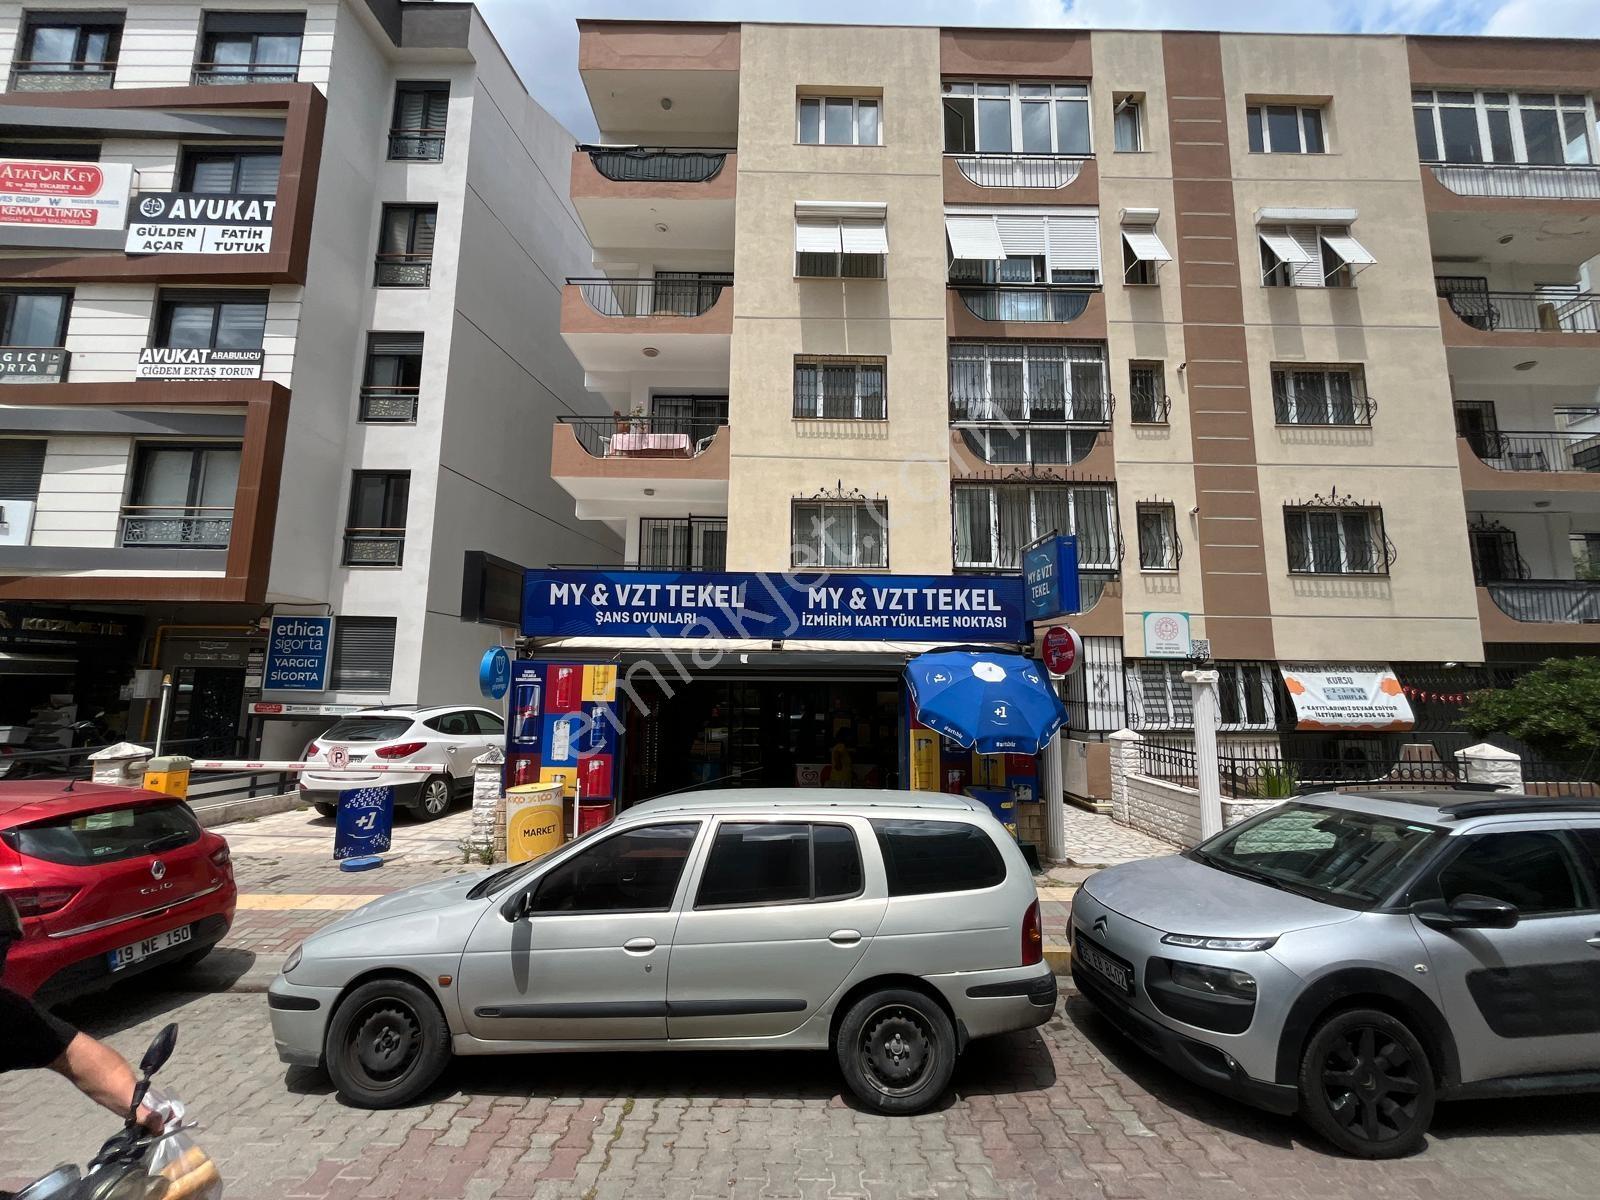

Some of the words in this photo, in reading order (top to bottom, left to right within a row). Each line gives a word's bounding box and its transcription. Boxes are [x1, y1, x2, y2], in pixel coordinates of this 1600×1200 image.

[168, 199, 277, 220] AVUKAT
[136, 226, 197, 238] GÜLDEN
[221, 228, 263, 239] FATİH
[142, 241, 183, 252] AÇAR
[214, 242, 265, 252] TUTUK
[140, 349, 211, 363] AVUKAT
[211, 352, 261, 360] ARABULUCU
[141, 365, 181, 376] ÇİĞDEM
[220, 367, 254, 376] TORUN
[550, 583, 586, 606] MY
[591, 583, 609, 606] &
[615, 584, 661, 607] VZT
[666, 585, 745, 608] TEKEL
[1031, 582, 1050, 599] TEKEL
[808, 587, 844, 609] MY
[850, 587, 867, 610] &
[872, 588, 918, 610] VZT
[922, 588, 1001, 611] TEKEL
[595, 611, 629, 625] ŞANS
[633, 612, 697, 624] OYUNLARI
[802, 611, 852, 627] İZMİRİM
[856, 615, 888, 627] KART
[890, 613, 949, 627] YÜKLEME
[953, 616, 1007, 628] NOKTASI
[277, 621, 324, 636] ethica
[274, 636, 322, 653] sigorta
[275, 658, 318, 668] YARGICI
[271, 670, 319, 681] SİGORTA
[1325, 676, 1354, 685] KURSU
[355, 811, 377, 830] +1
[523, 825, 556, 837] MARKET
[118, 946, 134, 963] 19
[141, 937, 159, 955] NE
[166, 926, 190, 946] 150
